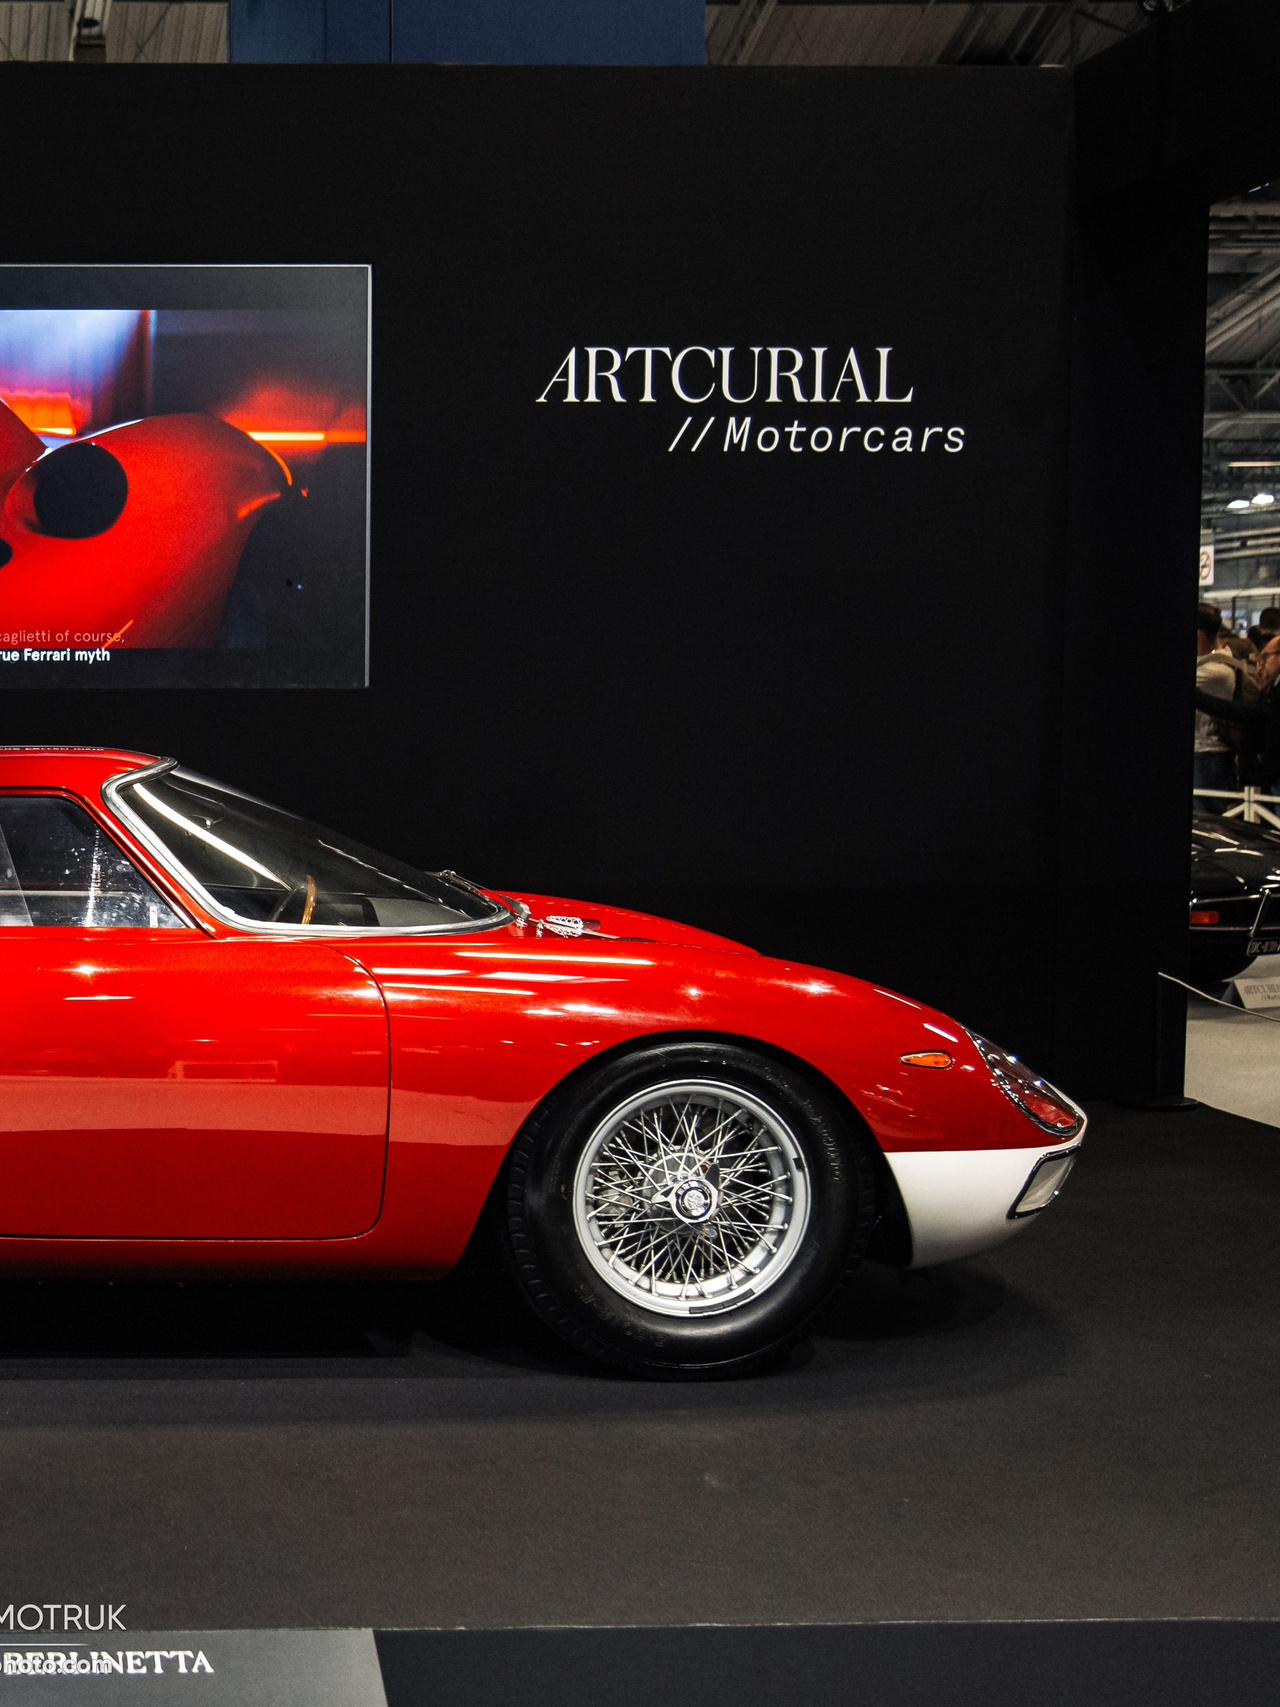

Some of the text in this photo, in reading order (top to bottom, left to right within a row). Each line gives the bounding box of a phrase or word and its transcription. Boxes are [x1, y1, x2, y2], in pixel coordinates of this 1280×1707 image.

[535, 346, 914, 404] ARTCURIAL
[55, 630, 70, 642] of
[23, 648, 71, 661] Ferrari
[75, 648, 111, 664] myth
